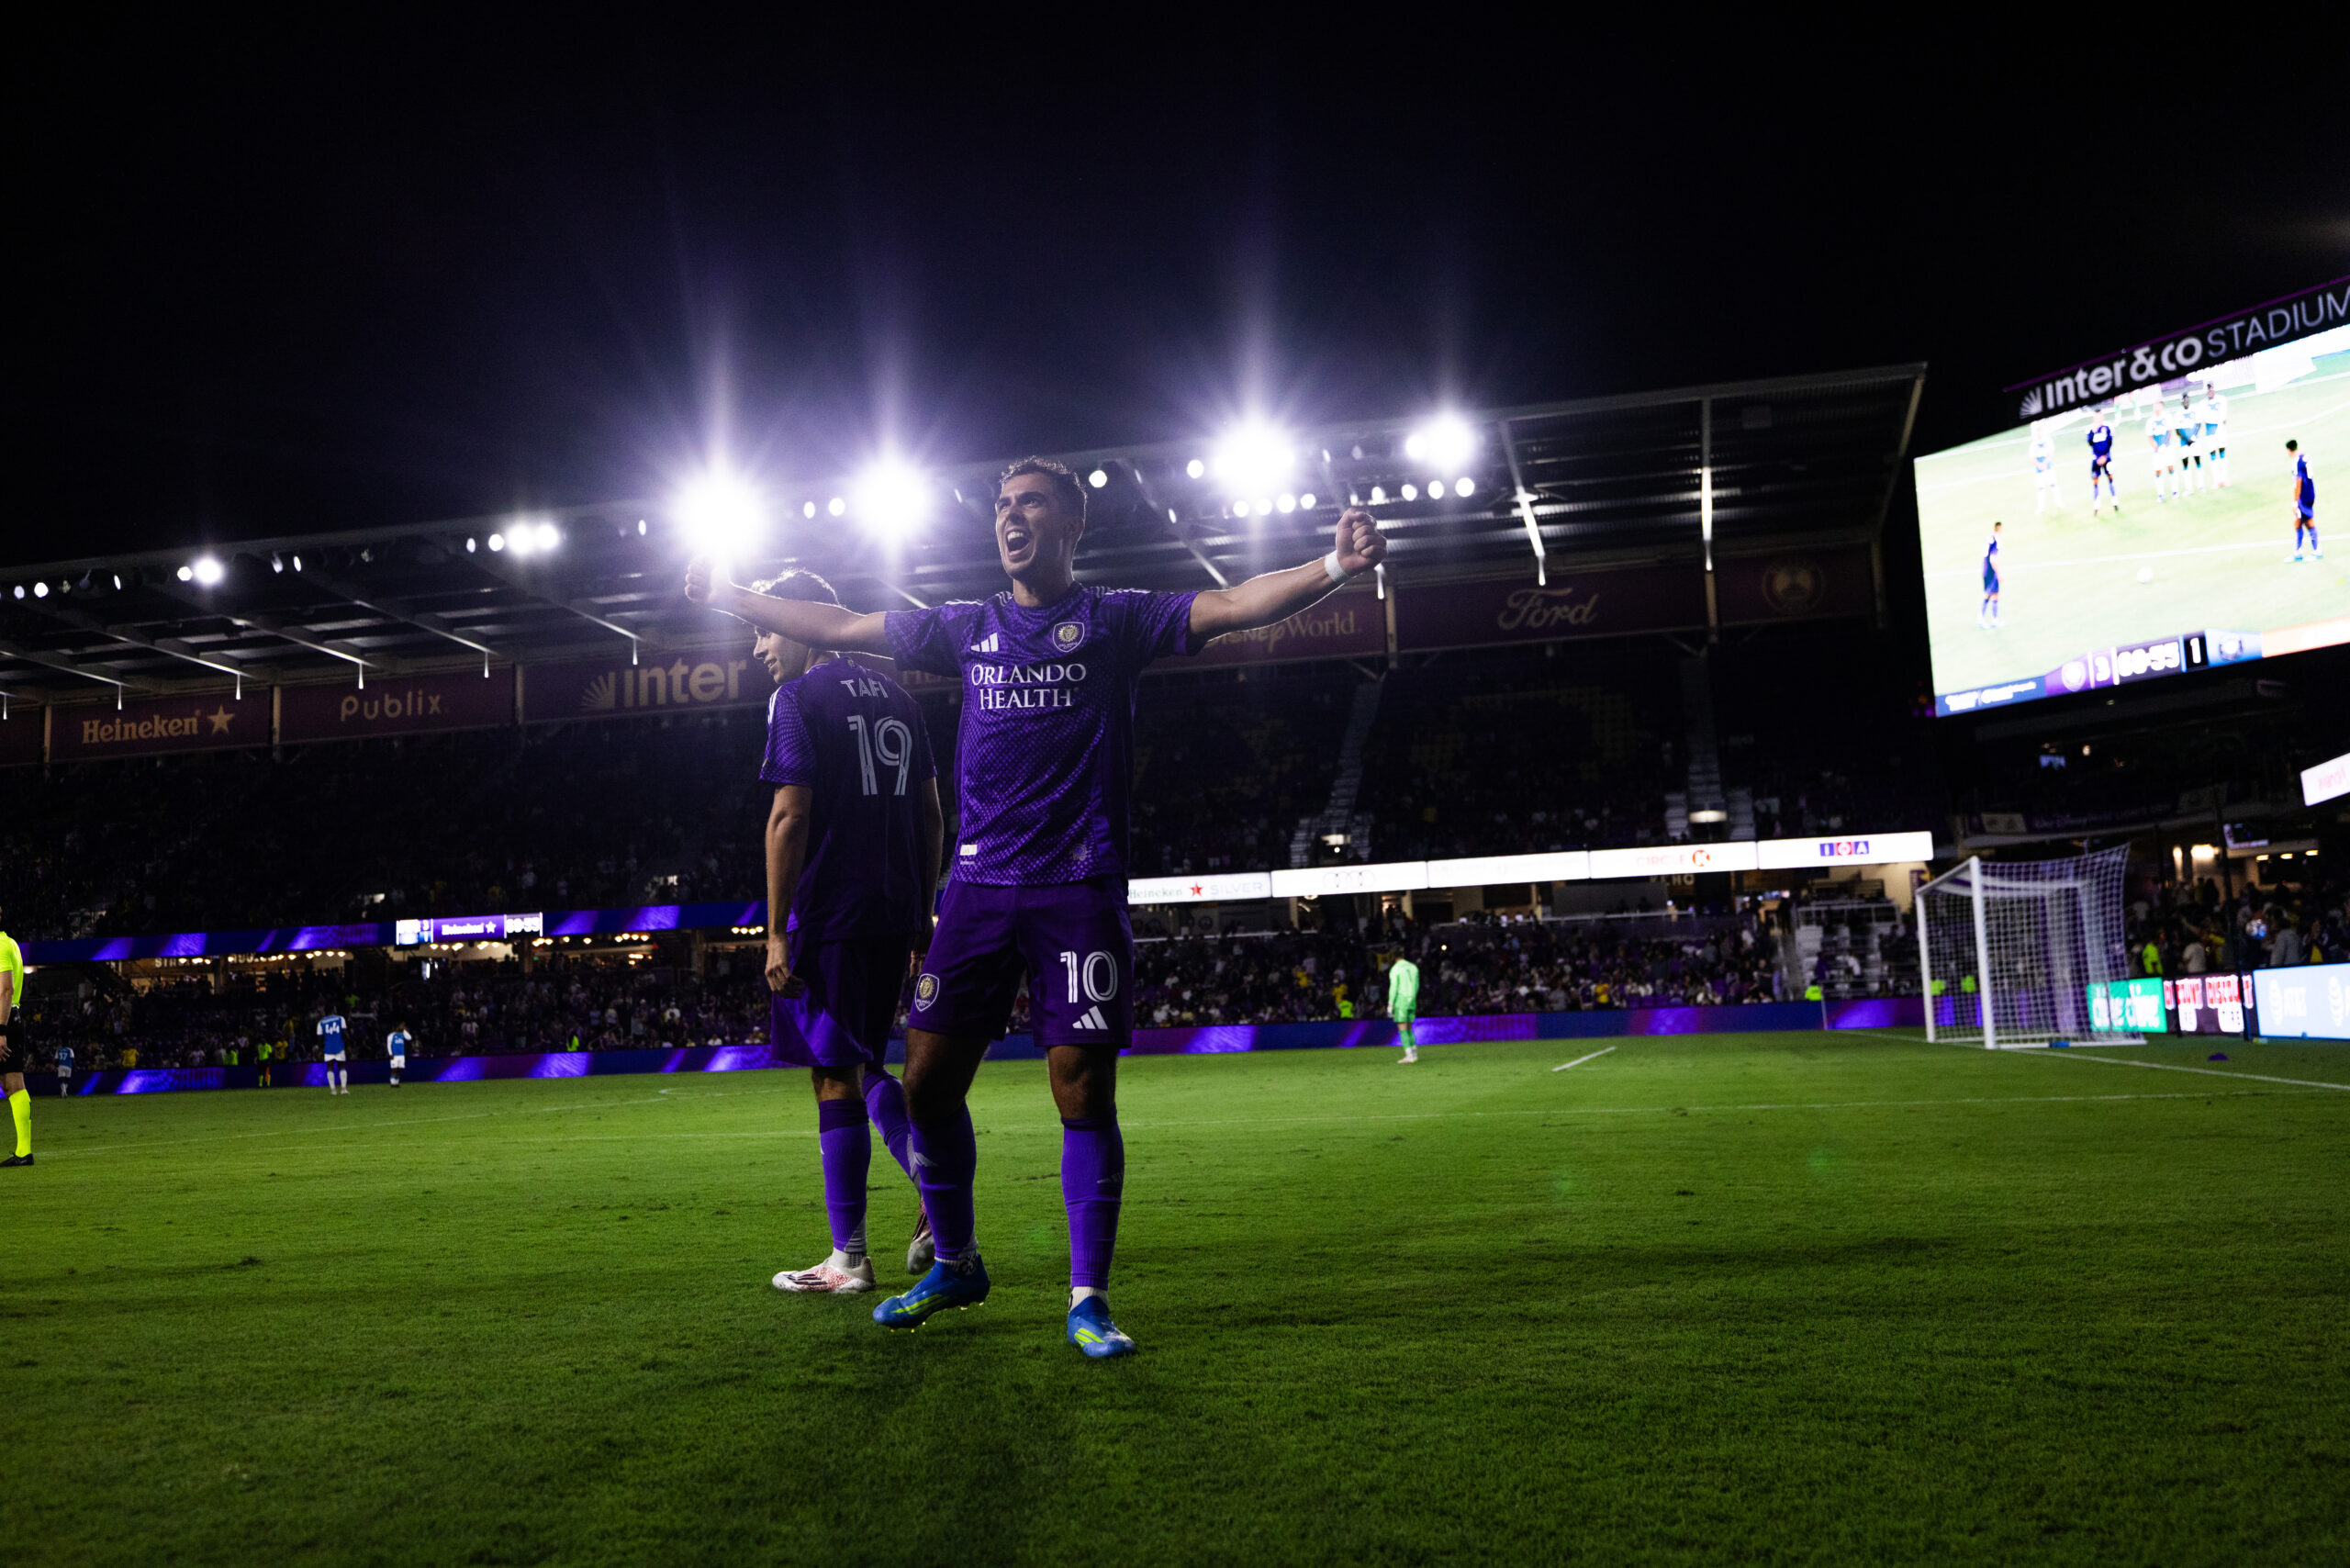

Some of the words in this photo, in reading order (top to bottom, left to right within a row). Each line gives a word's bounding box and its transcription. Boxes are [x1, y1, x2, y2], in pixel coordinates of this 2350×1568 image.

[1497, 588, 1600, 630] Ford
[1285, 610, 1354, 638] World
[971, 663, 1087, 686] ORLANDO
[2094, 655, 2110, 682] 3
[840, 678, 889, 698] TAFI
[979, 688, 1073, 711] HEALTH
[82, 713, 199, 745] Heineken
[846, 714, 912, 796] 19
[1128, 887, 1182, 900] Heineken
[1210, 881, 1263, 895] SILVER
[1059, 950, 1118, 1003] 10
[324, 1022, 341, 1036] 44
